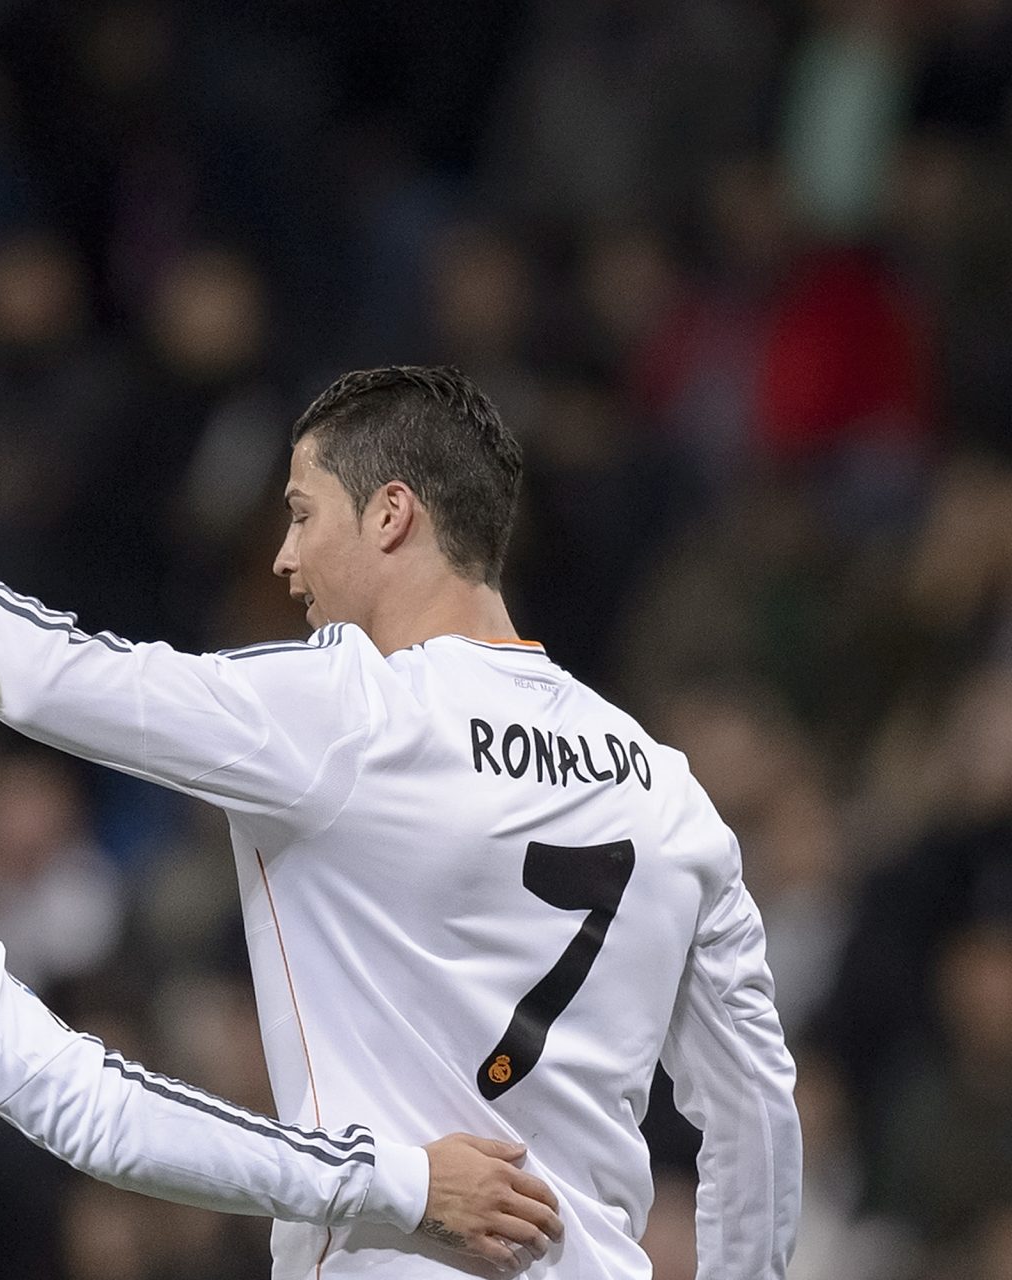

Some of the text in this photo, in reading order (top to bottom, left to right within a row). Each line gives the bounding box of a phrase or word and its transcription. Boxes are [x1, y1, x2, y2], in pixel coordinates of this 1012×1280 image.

[513, 678, 537, 690] REAL
[470, 717, 652, 792] RONALDO
[476, 837, 637, 1101] 7
